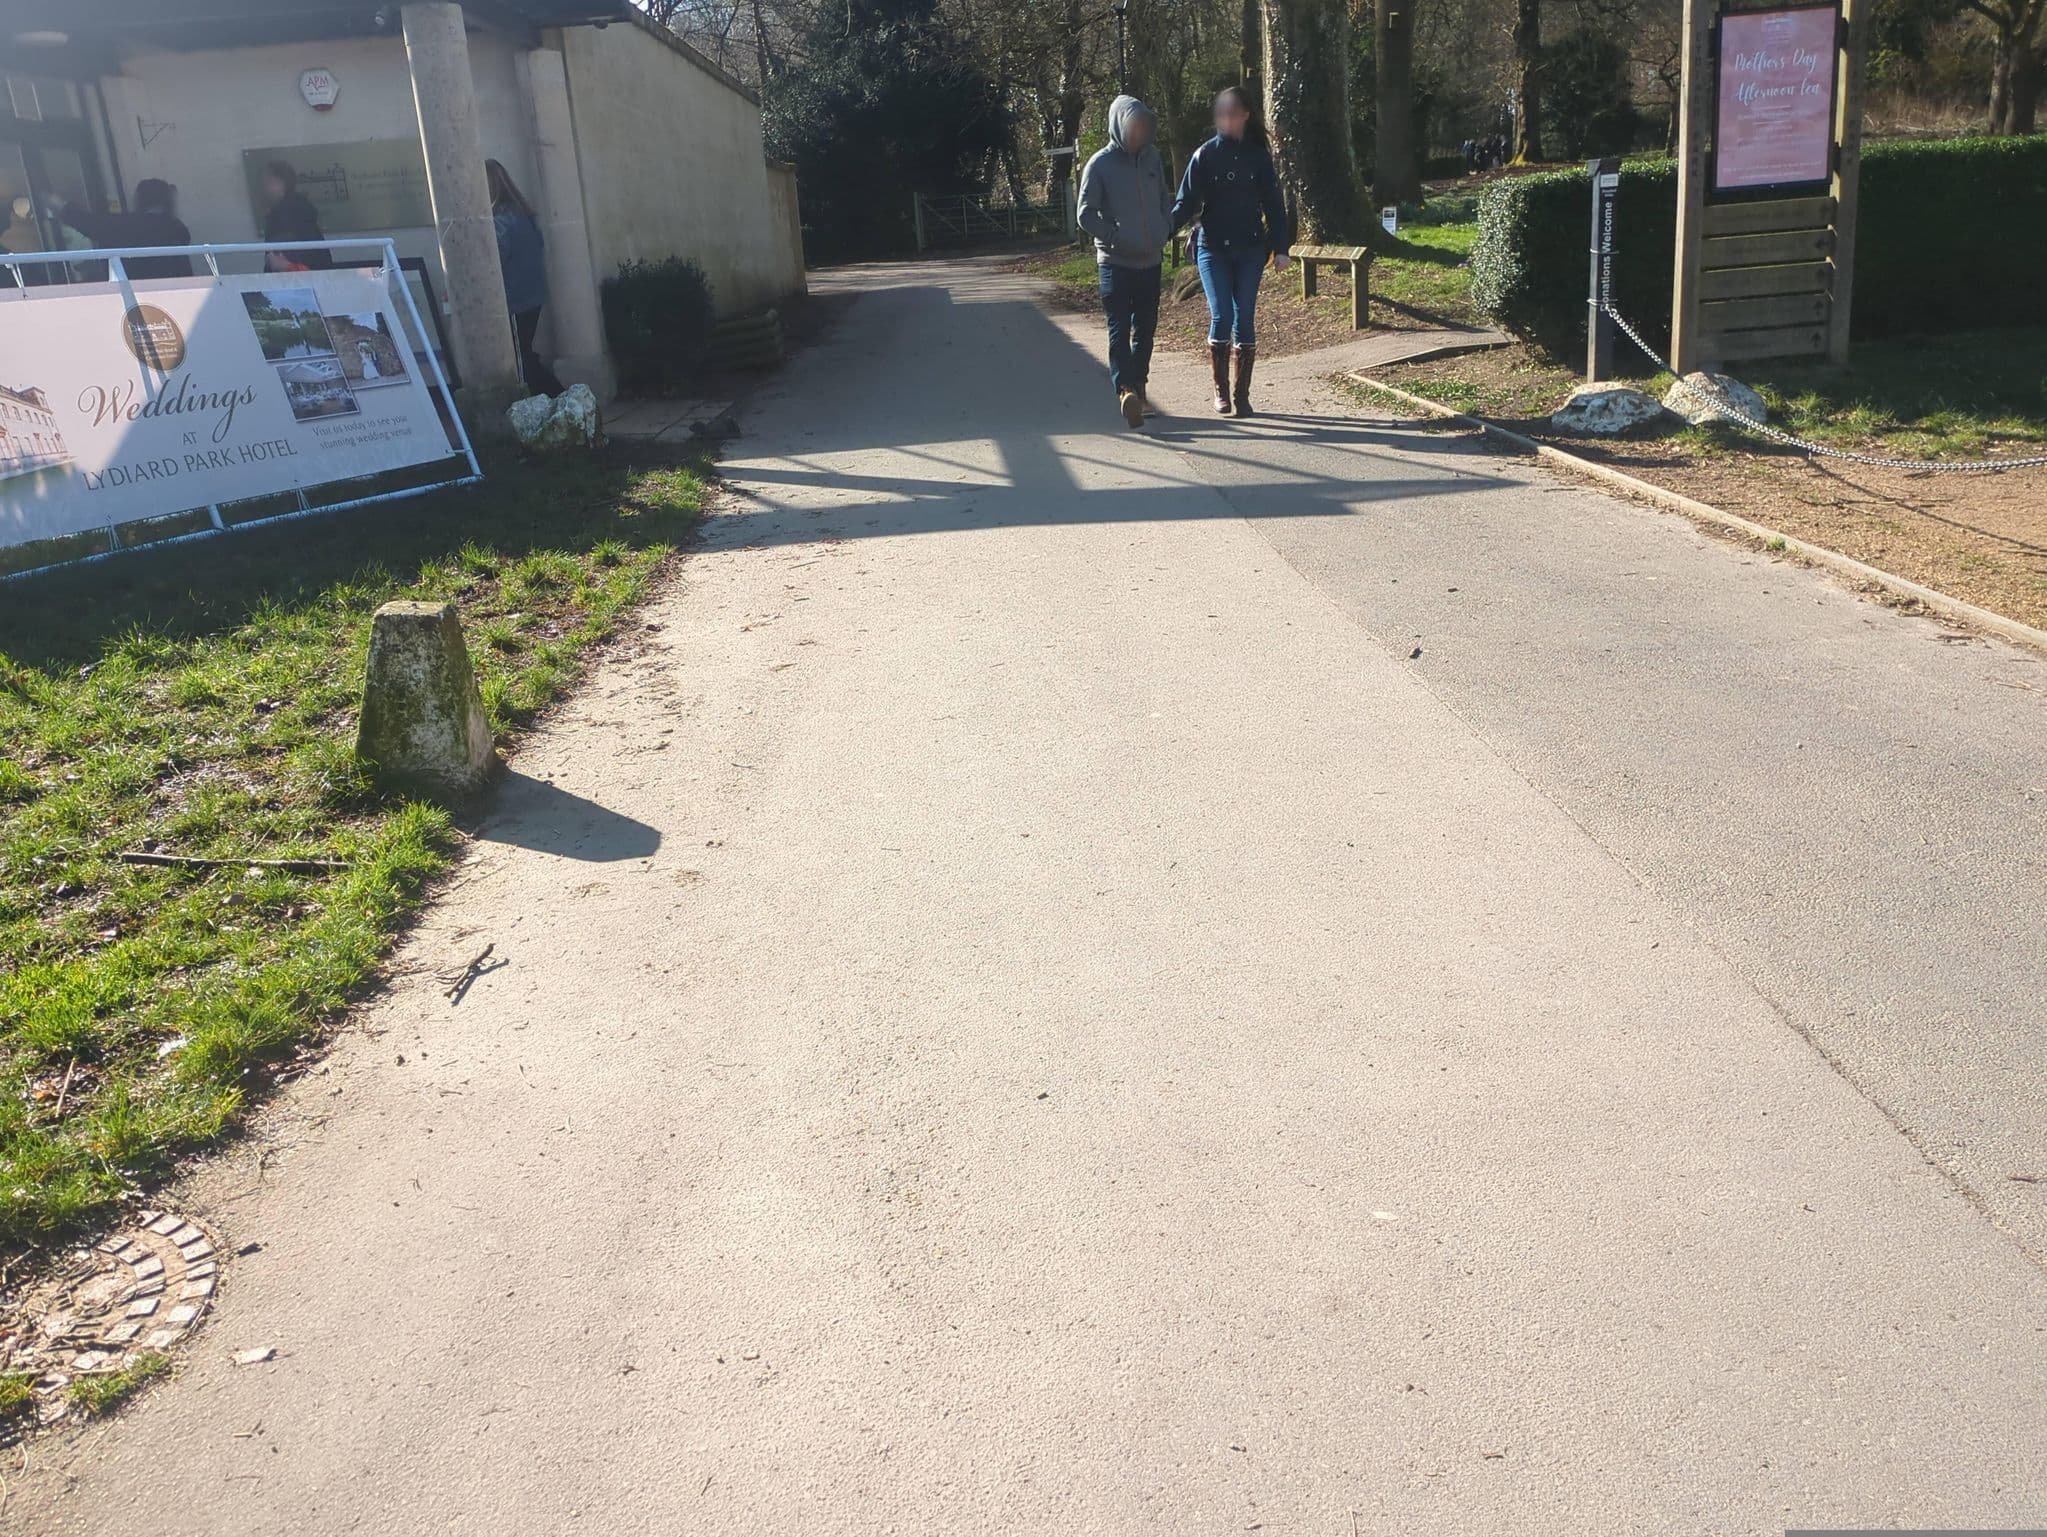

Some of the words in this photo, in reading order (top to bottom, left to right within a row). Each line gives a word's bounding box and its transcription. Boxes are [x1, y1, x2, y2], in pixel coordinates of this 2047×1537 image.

[1792, 48, 1817, 74] Day
[1736, 82, 1795, 106] Afternoon
[1602, 202, 1613, 254] Welcome
[77, 373, 257, 443] Weddings
[182, 431, 198, 446] AT
[344, 421, 367, 432] today
[82, 457, 180, 491] LYDIARD
[183, 446, 236, 473] PARK
[238, 439, 299, 464] HOTEL
